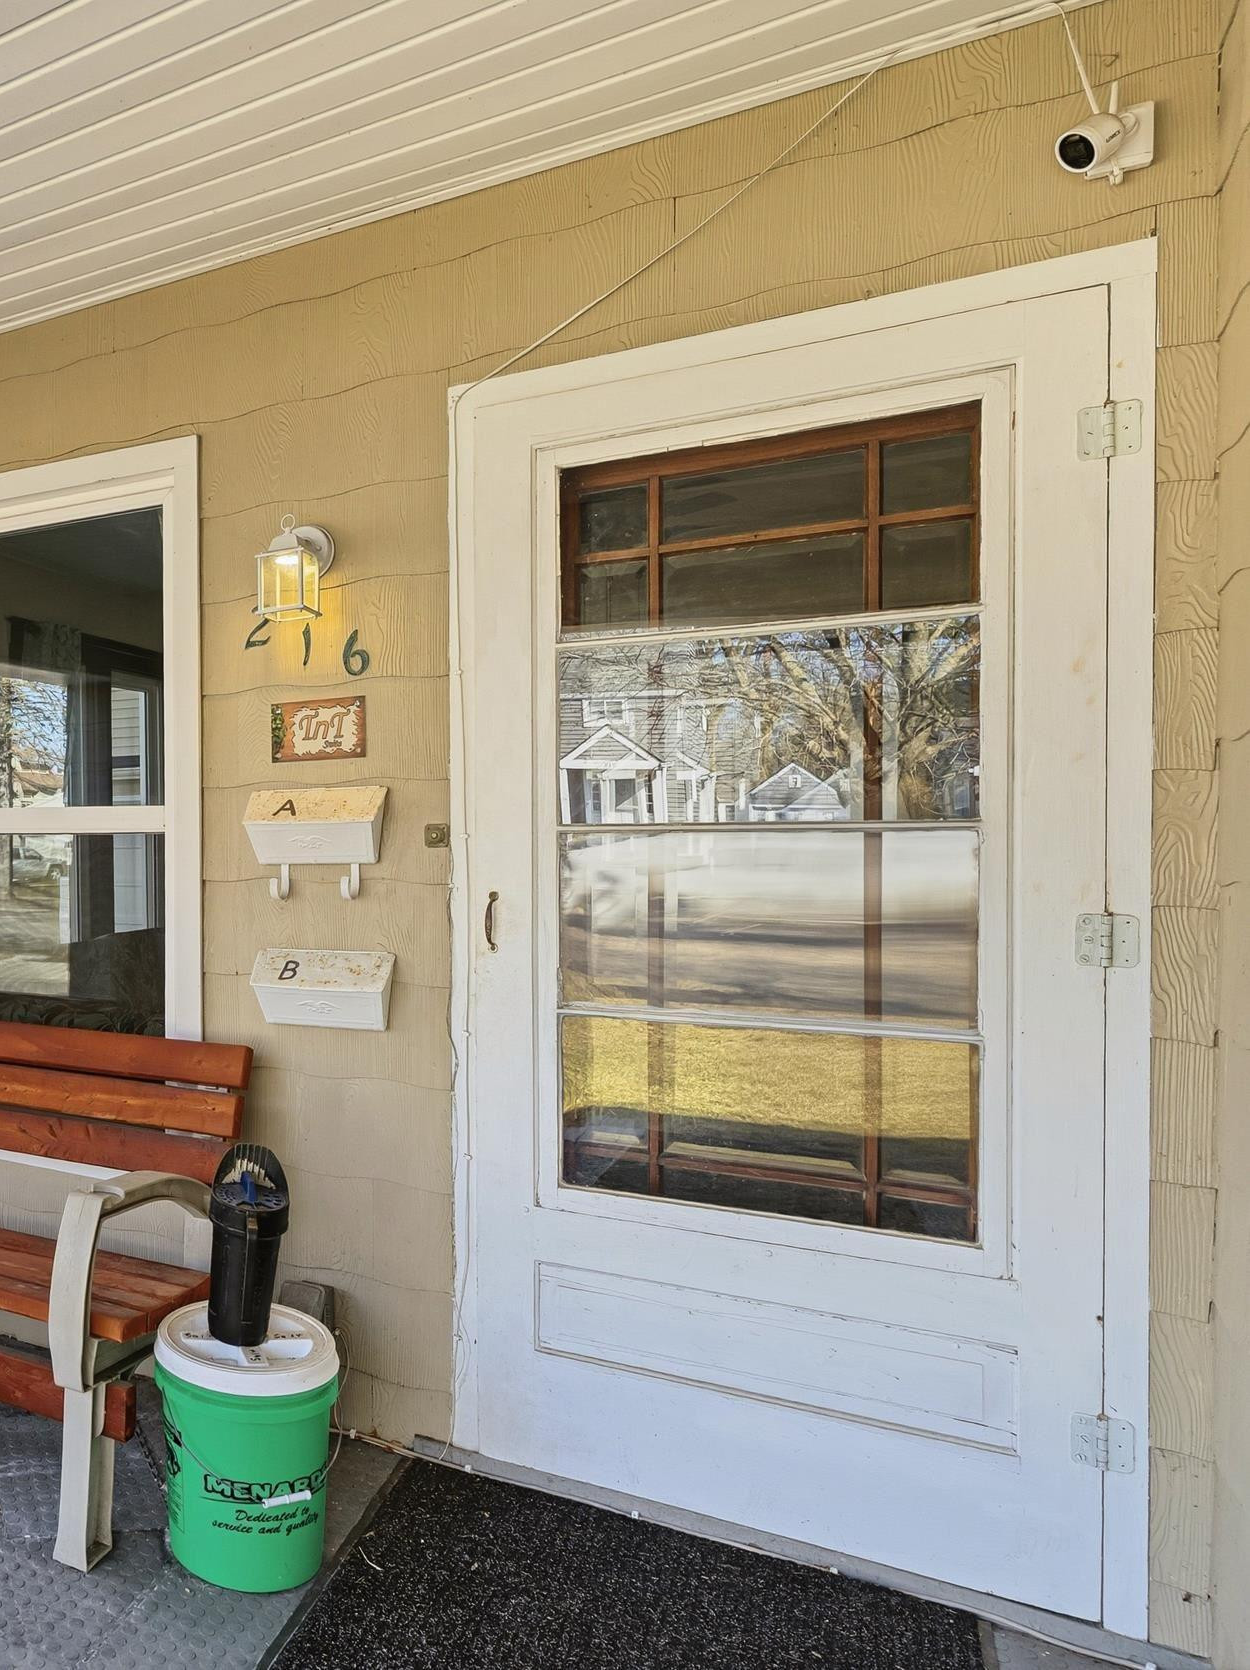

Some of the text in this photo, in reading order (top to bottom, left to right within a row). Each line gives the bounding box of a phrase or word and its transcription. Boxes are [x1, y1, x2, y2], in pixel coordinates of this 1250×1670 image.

[244, 606, 370, 676] 216
[272, 799, 297, 817] A
[278, 960, 300, 980] B
[235, 1505, 310, 1522] Dedicated to
[212, 1512, 319, 1536] service and quality
